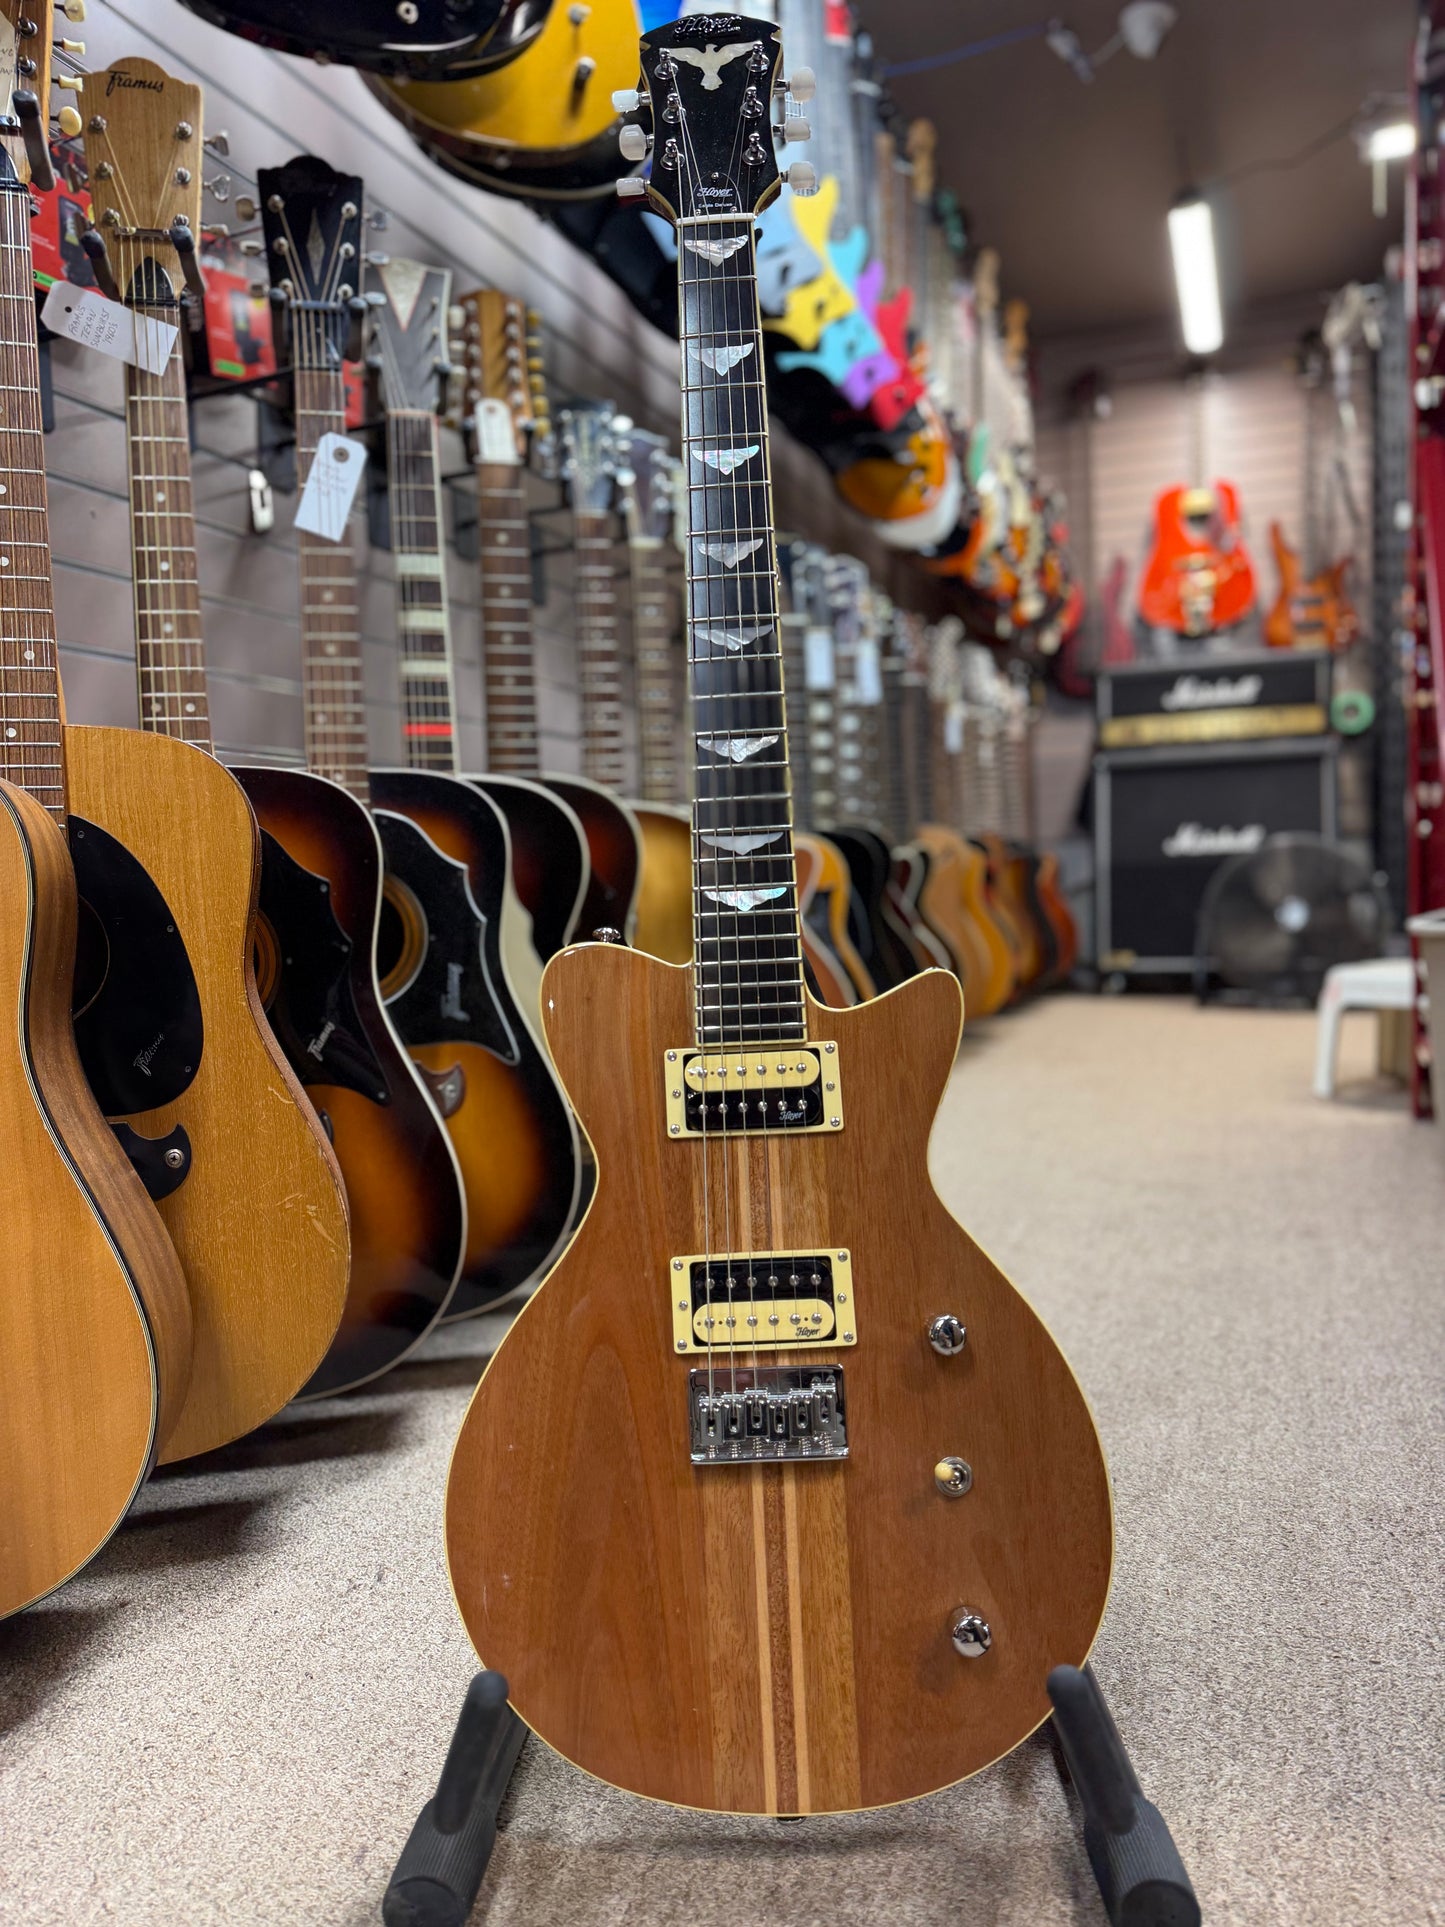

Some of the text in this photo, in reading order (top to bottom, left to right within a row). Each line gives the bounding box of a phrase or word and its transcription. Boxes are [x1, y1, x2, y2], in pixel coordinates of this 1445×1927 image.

[106, 70, 164, 97] Framus
[697, 187, 733, 197] Hoyer
[80, 308, 97, 339] TEXAN
[90, 307, 110, 348] SUNBURST
[779, 1110, 804, 1121] Hoyer
[795, 1326, 821, 1338] Hoyer
